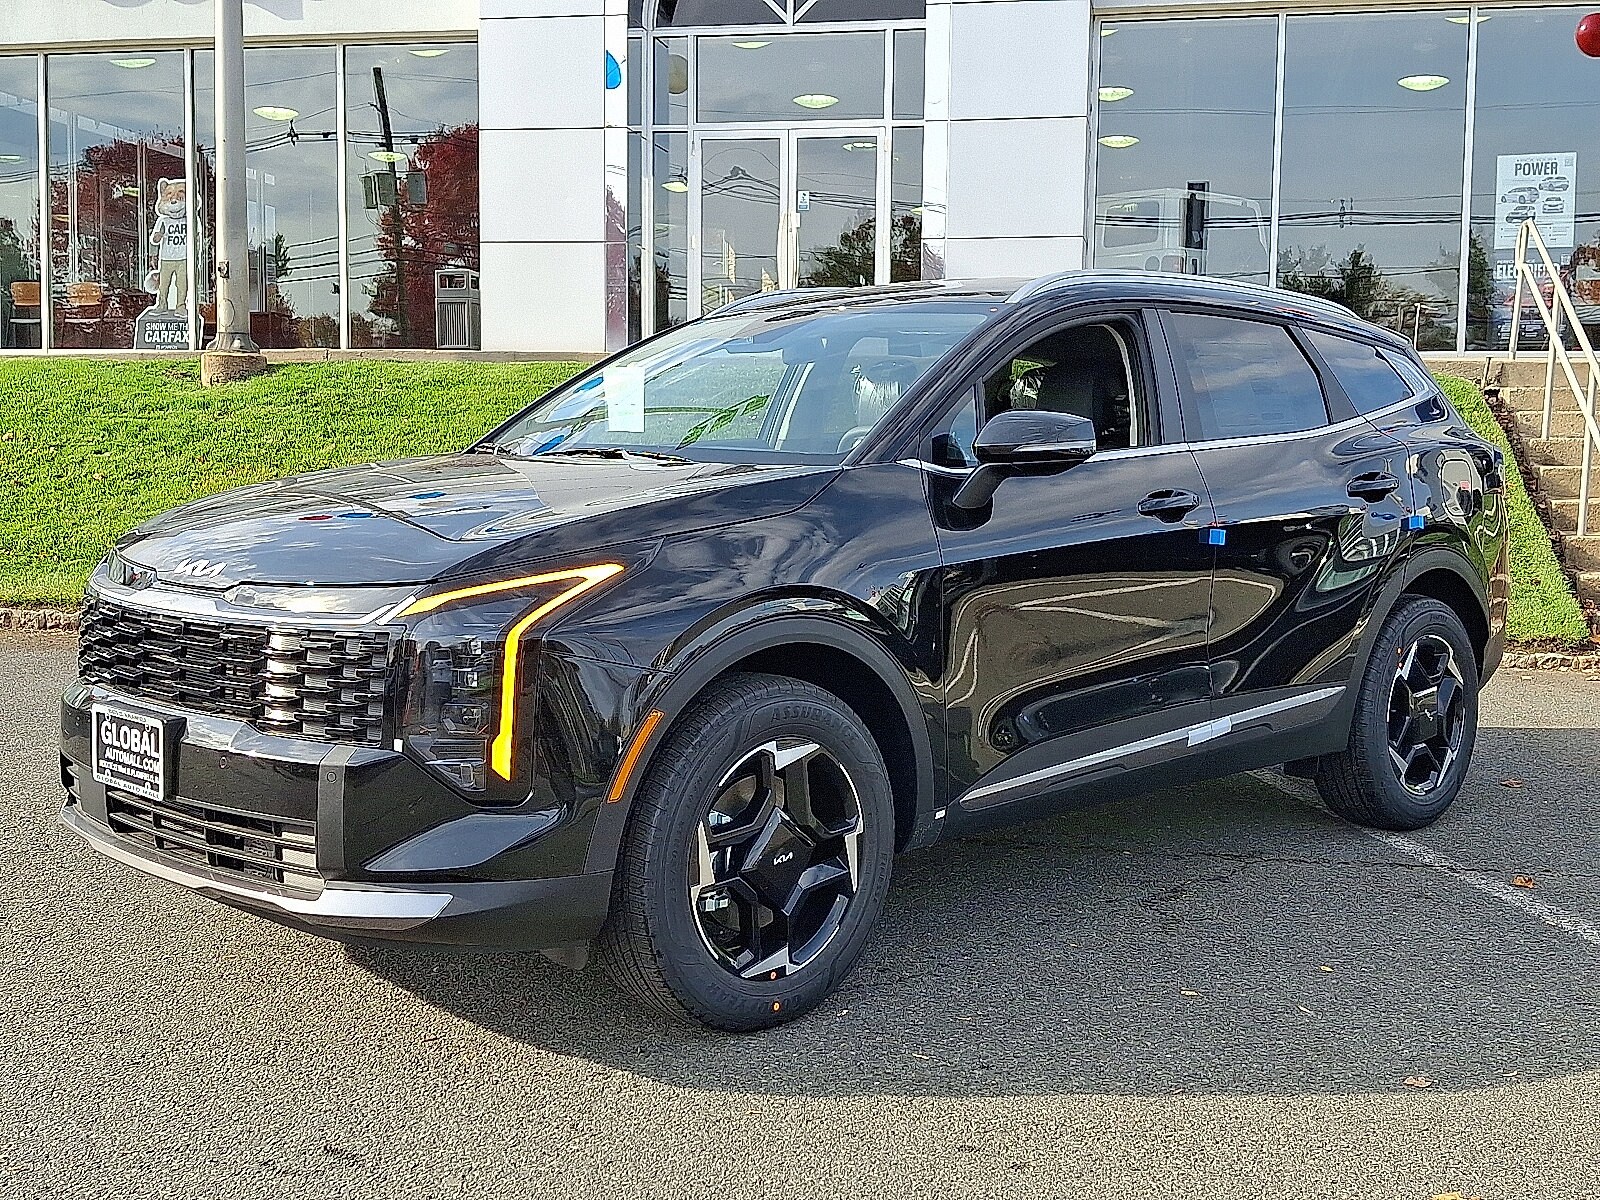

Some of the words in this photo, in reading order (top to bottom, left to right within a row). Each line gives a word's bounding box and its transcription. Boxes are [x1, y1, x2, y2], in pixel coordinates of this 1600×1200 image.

[1514, 162, 1558, 176] POWER
[168, 224, 187, 235] CAR
[167, 236, 186, 246] FOX
[145, 322, 167, 331] SHOW
[168, 323, 178, 331] ME
[178, 323, 189, 331] TH
[144, 331, 190, 343] CARFAX
[101, 720, 160, 758] GLOBAL
